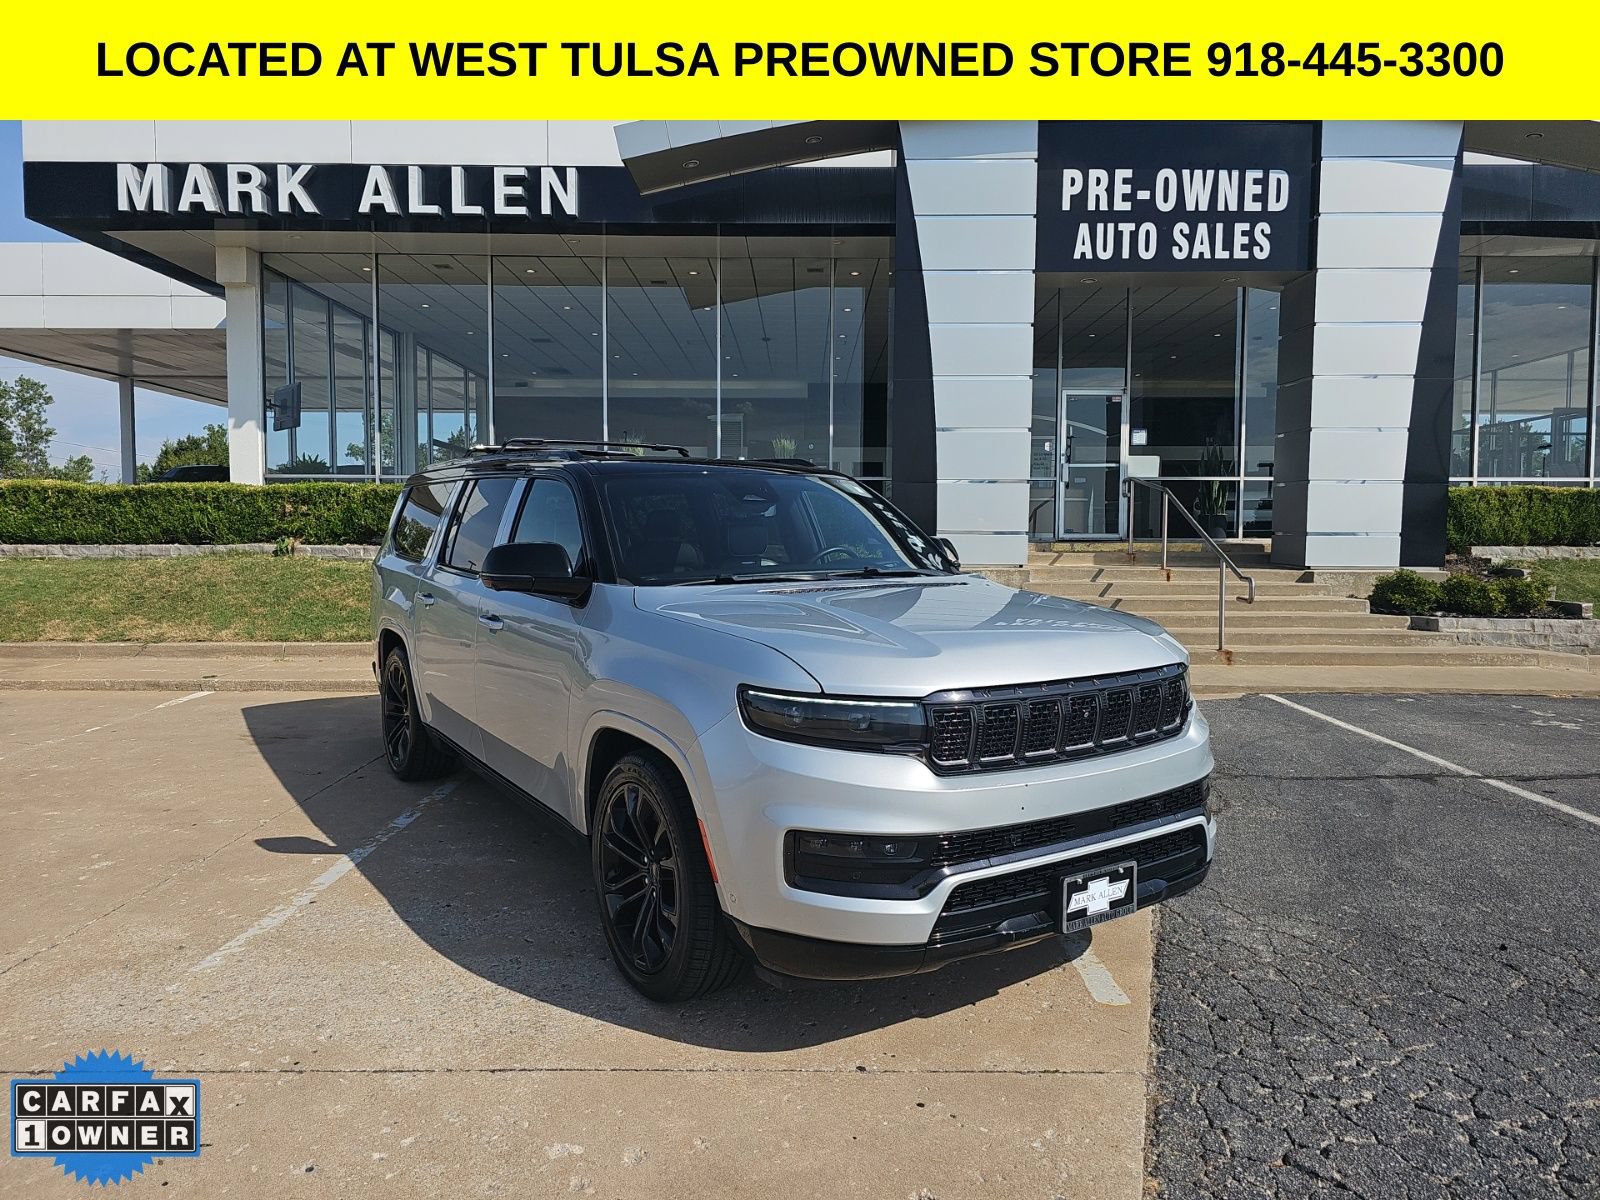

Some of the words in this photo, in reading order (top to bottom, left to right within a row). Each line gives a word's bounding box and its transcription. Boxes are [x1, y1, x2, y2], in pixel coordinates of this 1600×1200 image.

[116, 163, 320, 216] MARK
[358, 164, 580, 217] ALLEN
[1062, 168, 1290, 212] PRE-OWNED
[1073, 222, 1158, 260] AUTO
[1172, 222, 1271, 260] SALES
[1074, 892, 1097, 907] MARK
[1098, 885, 1123, 900] ALLEN
